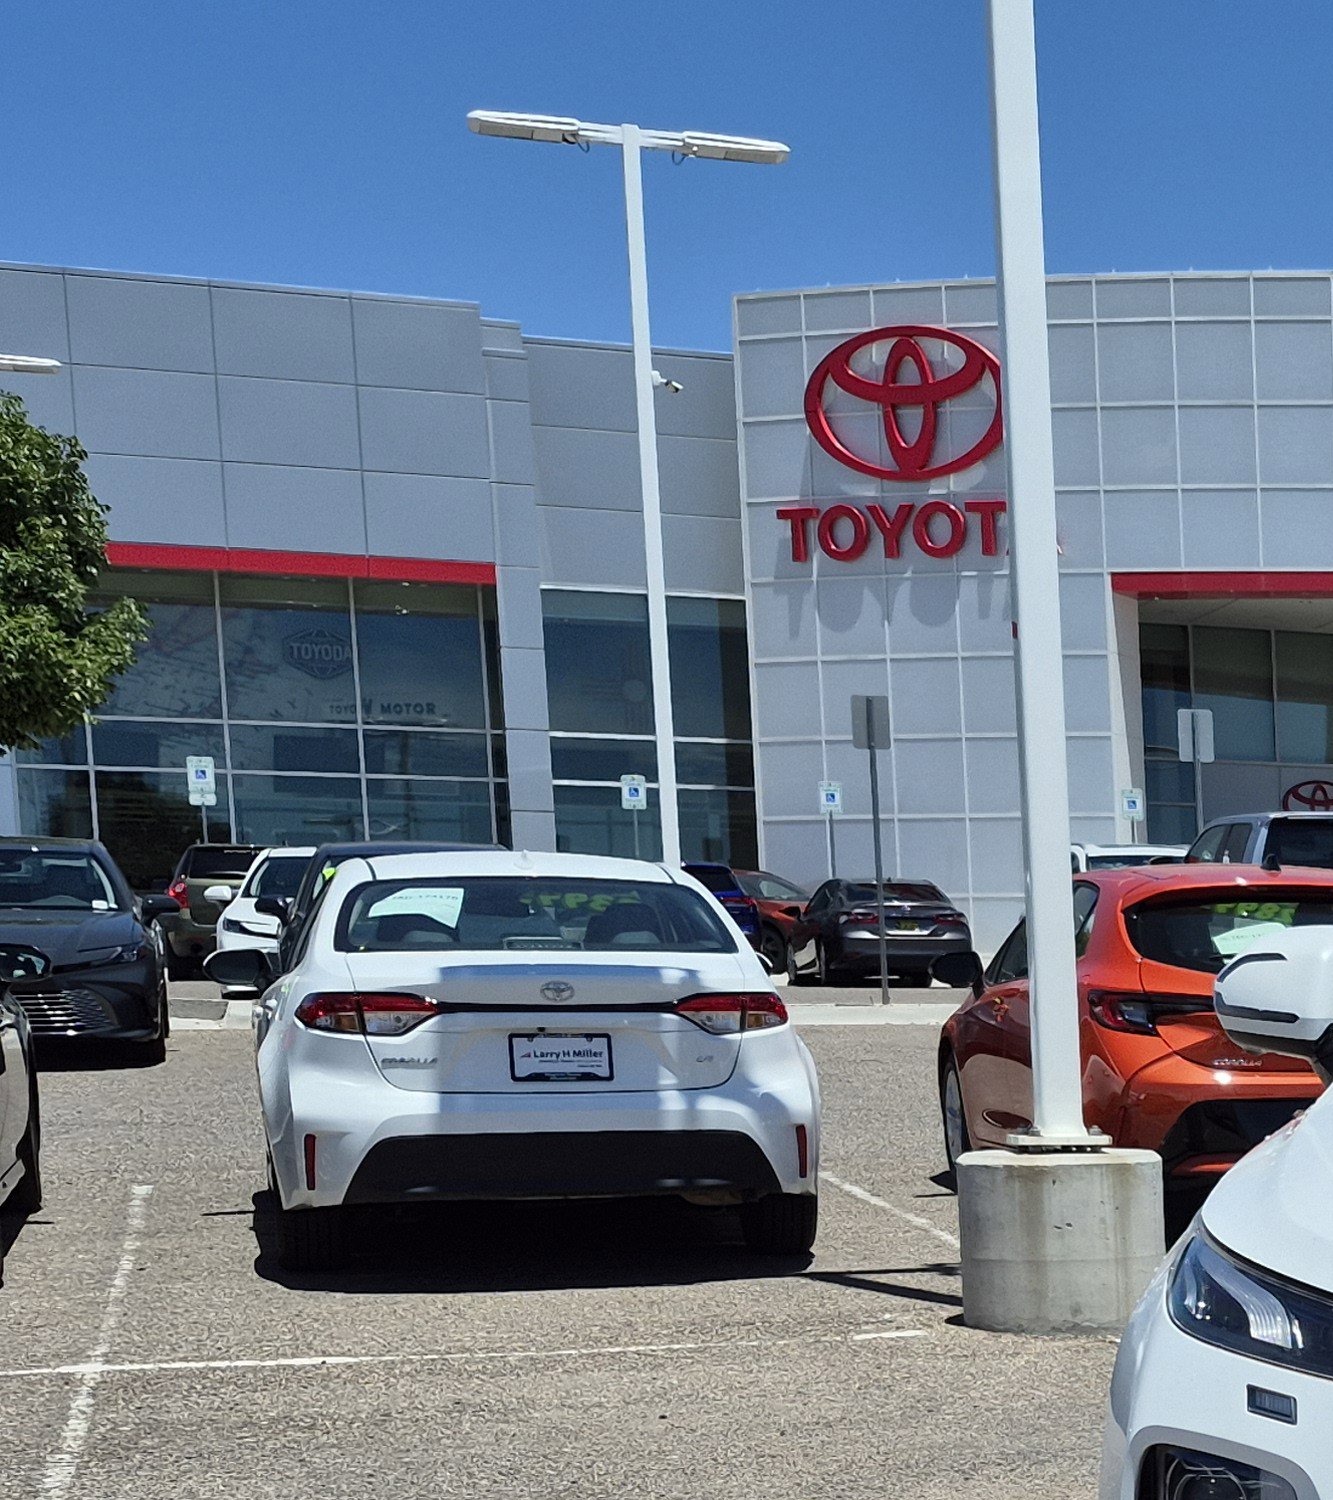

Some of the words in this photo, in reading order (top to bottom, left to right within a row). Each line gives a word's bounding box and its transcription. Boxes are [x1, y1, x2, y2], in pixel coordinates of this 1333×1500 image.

[776, 499, 1061, 562] TOYOT
[380, 702, 436, 715] MOTOR
[533, 1050, 561, 1060] Larry
[562, 1050, 570, 1058] H
[573, 1049, 603, 1058] Miller
